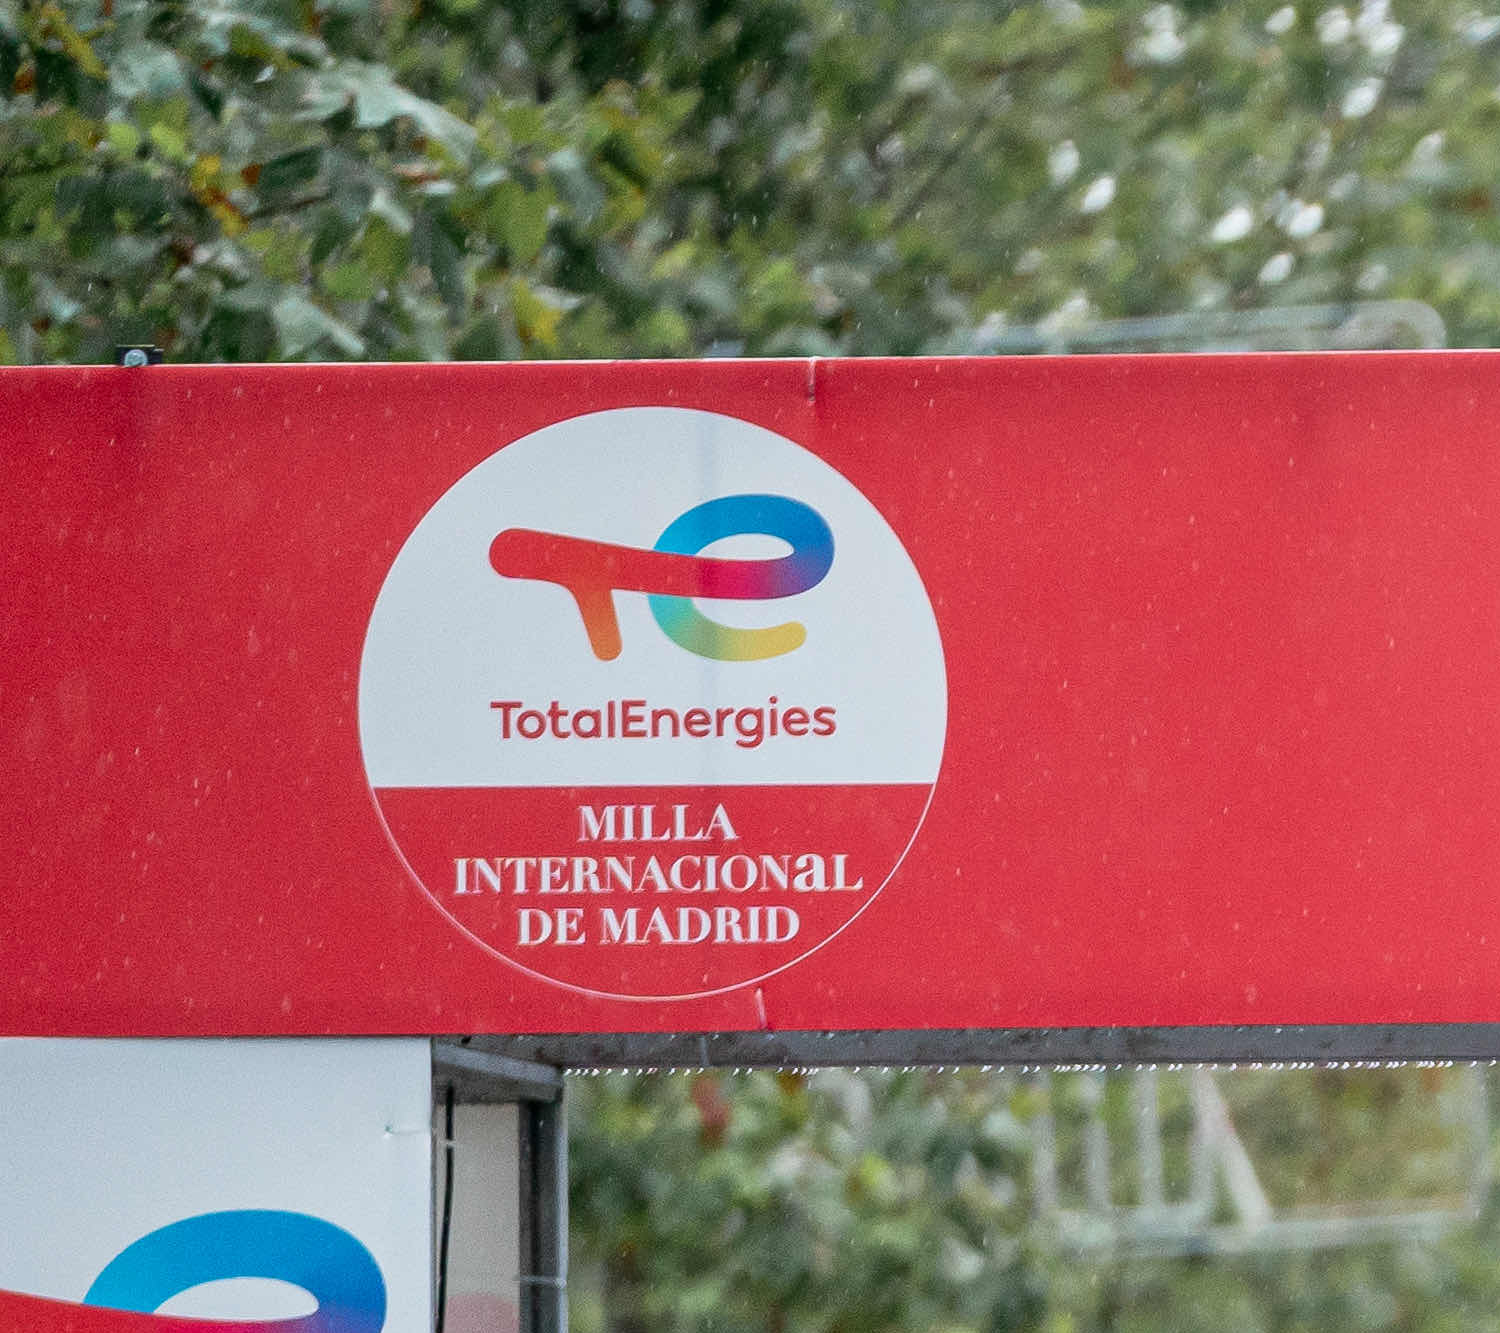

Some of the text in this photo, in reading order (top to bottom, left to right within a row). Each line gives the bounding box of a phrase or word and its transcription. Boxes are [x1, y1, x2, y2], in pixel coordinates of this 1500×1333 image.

[490, 696, 836, 748] TotalEnergies
[579, 804, 738, 841] MILLA
[518, 906, 800, 945] DE MADRID
